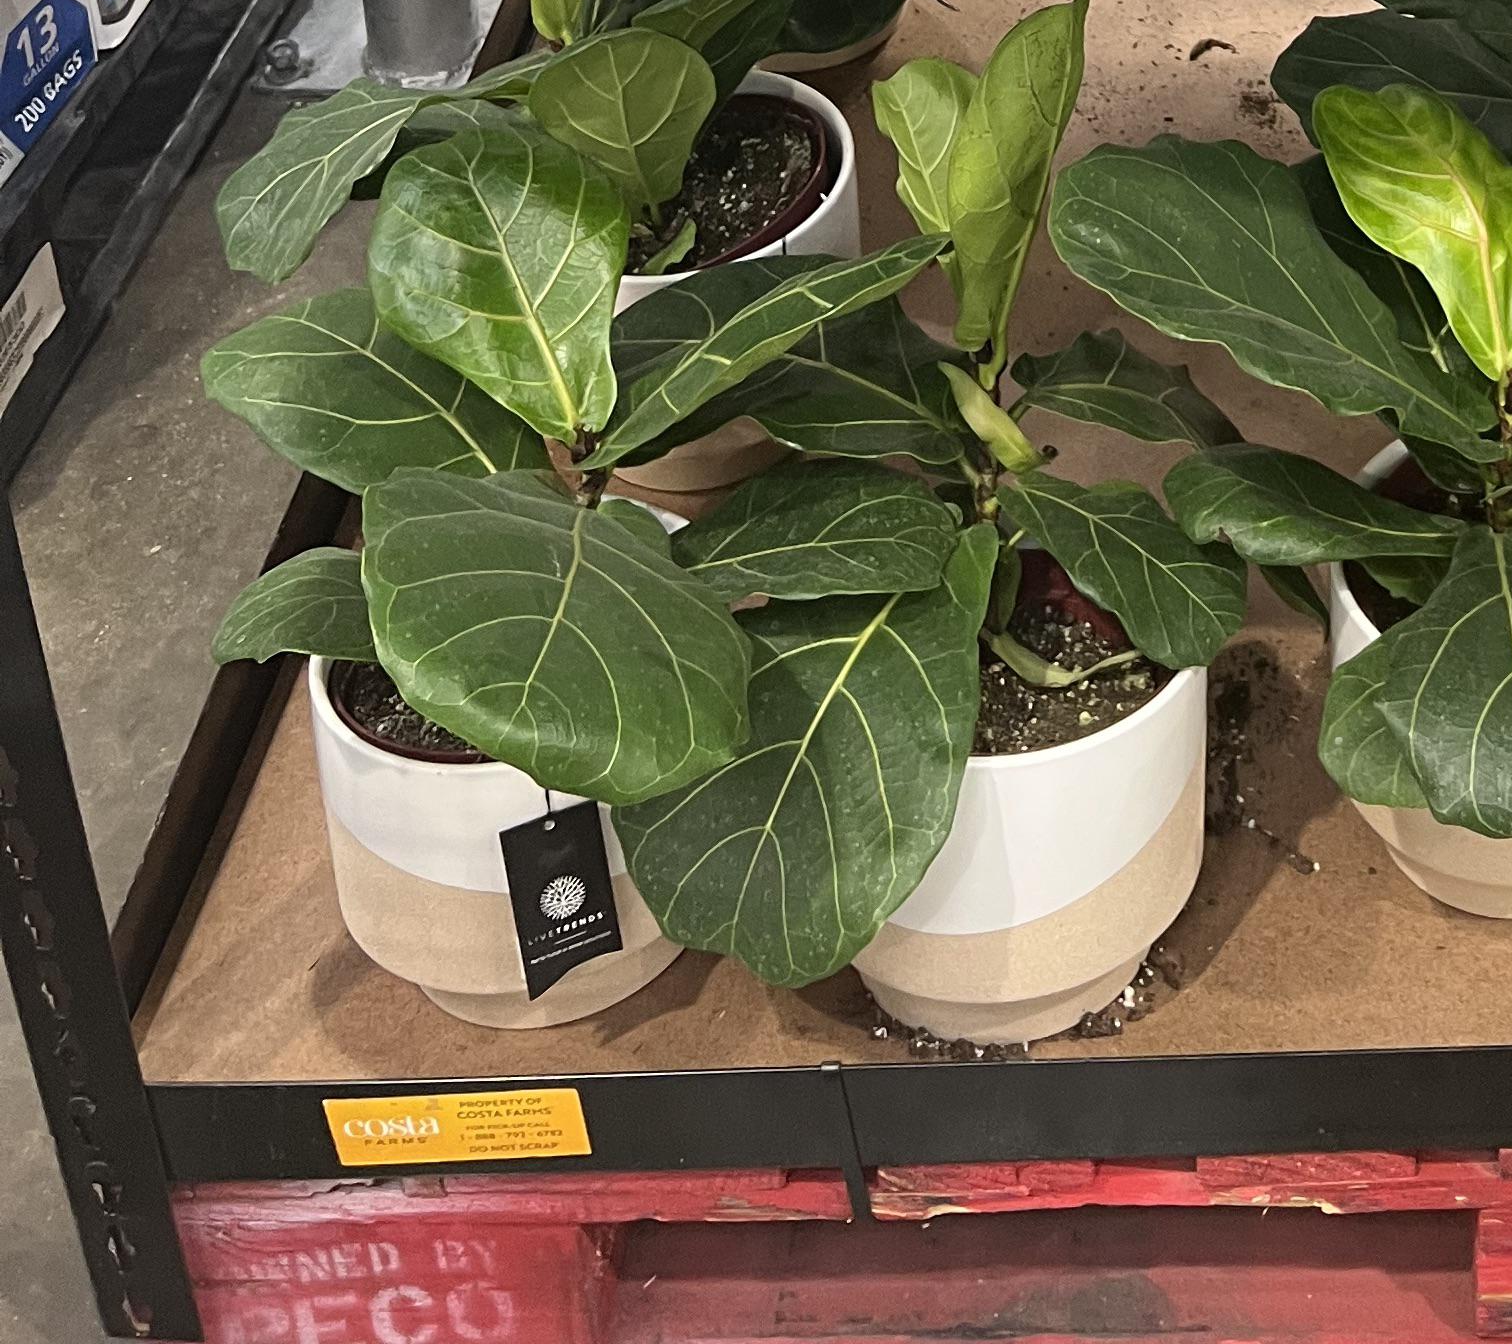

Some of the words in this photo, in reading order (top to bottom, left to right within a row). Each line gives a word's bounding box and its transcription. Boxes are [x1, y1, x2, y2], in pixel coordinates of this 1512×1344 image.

[17, 4, 58, 68] 13
[15, 96, 46, 133] 200
[43, 49, 83, 102] BAGS
[528, 912, 604, 947] LIVETRENDS
[457, 1110, 503, 1119] COSTA
[506, 1107, 552, 1117] FARMS
[459, 1097, 523, 1108] PROPERTY
[526, 1097, 542, 1105] OF
[343, 1115, 440, 1138] costa
[364, 1136, 429, 1146] FARMS
